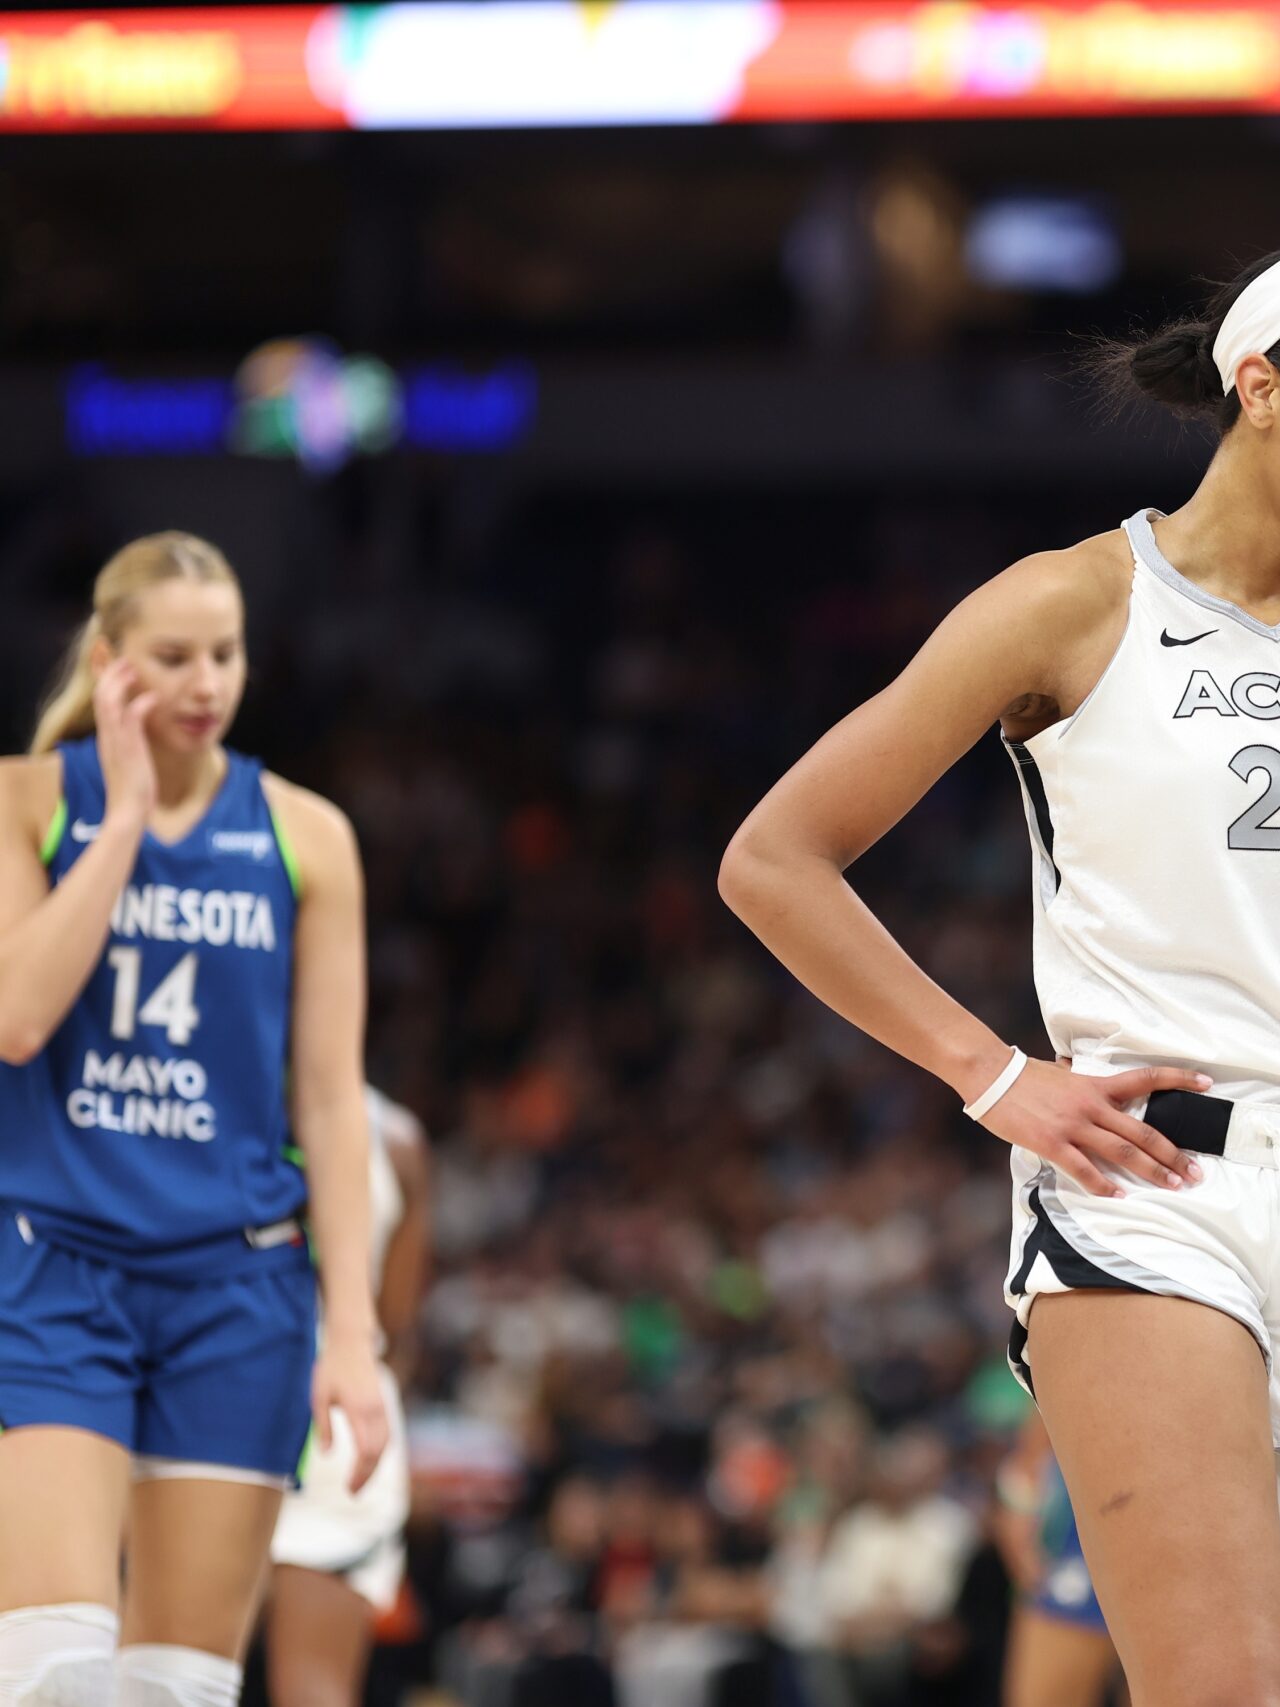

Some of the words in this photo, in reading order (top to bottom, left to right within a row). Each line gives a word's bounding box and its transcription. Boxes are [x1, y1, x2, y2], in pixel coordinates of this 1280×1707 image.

[107, 946, 200, 1046] 14
[83, 1050, 207, 1100] MAYO
[67, 1090, 216, 1142] CLINIC
